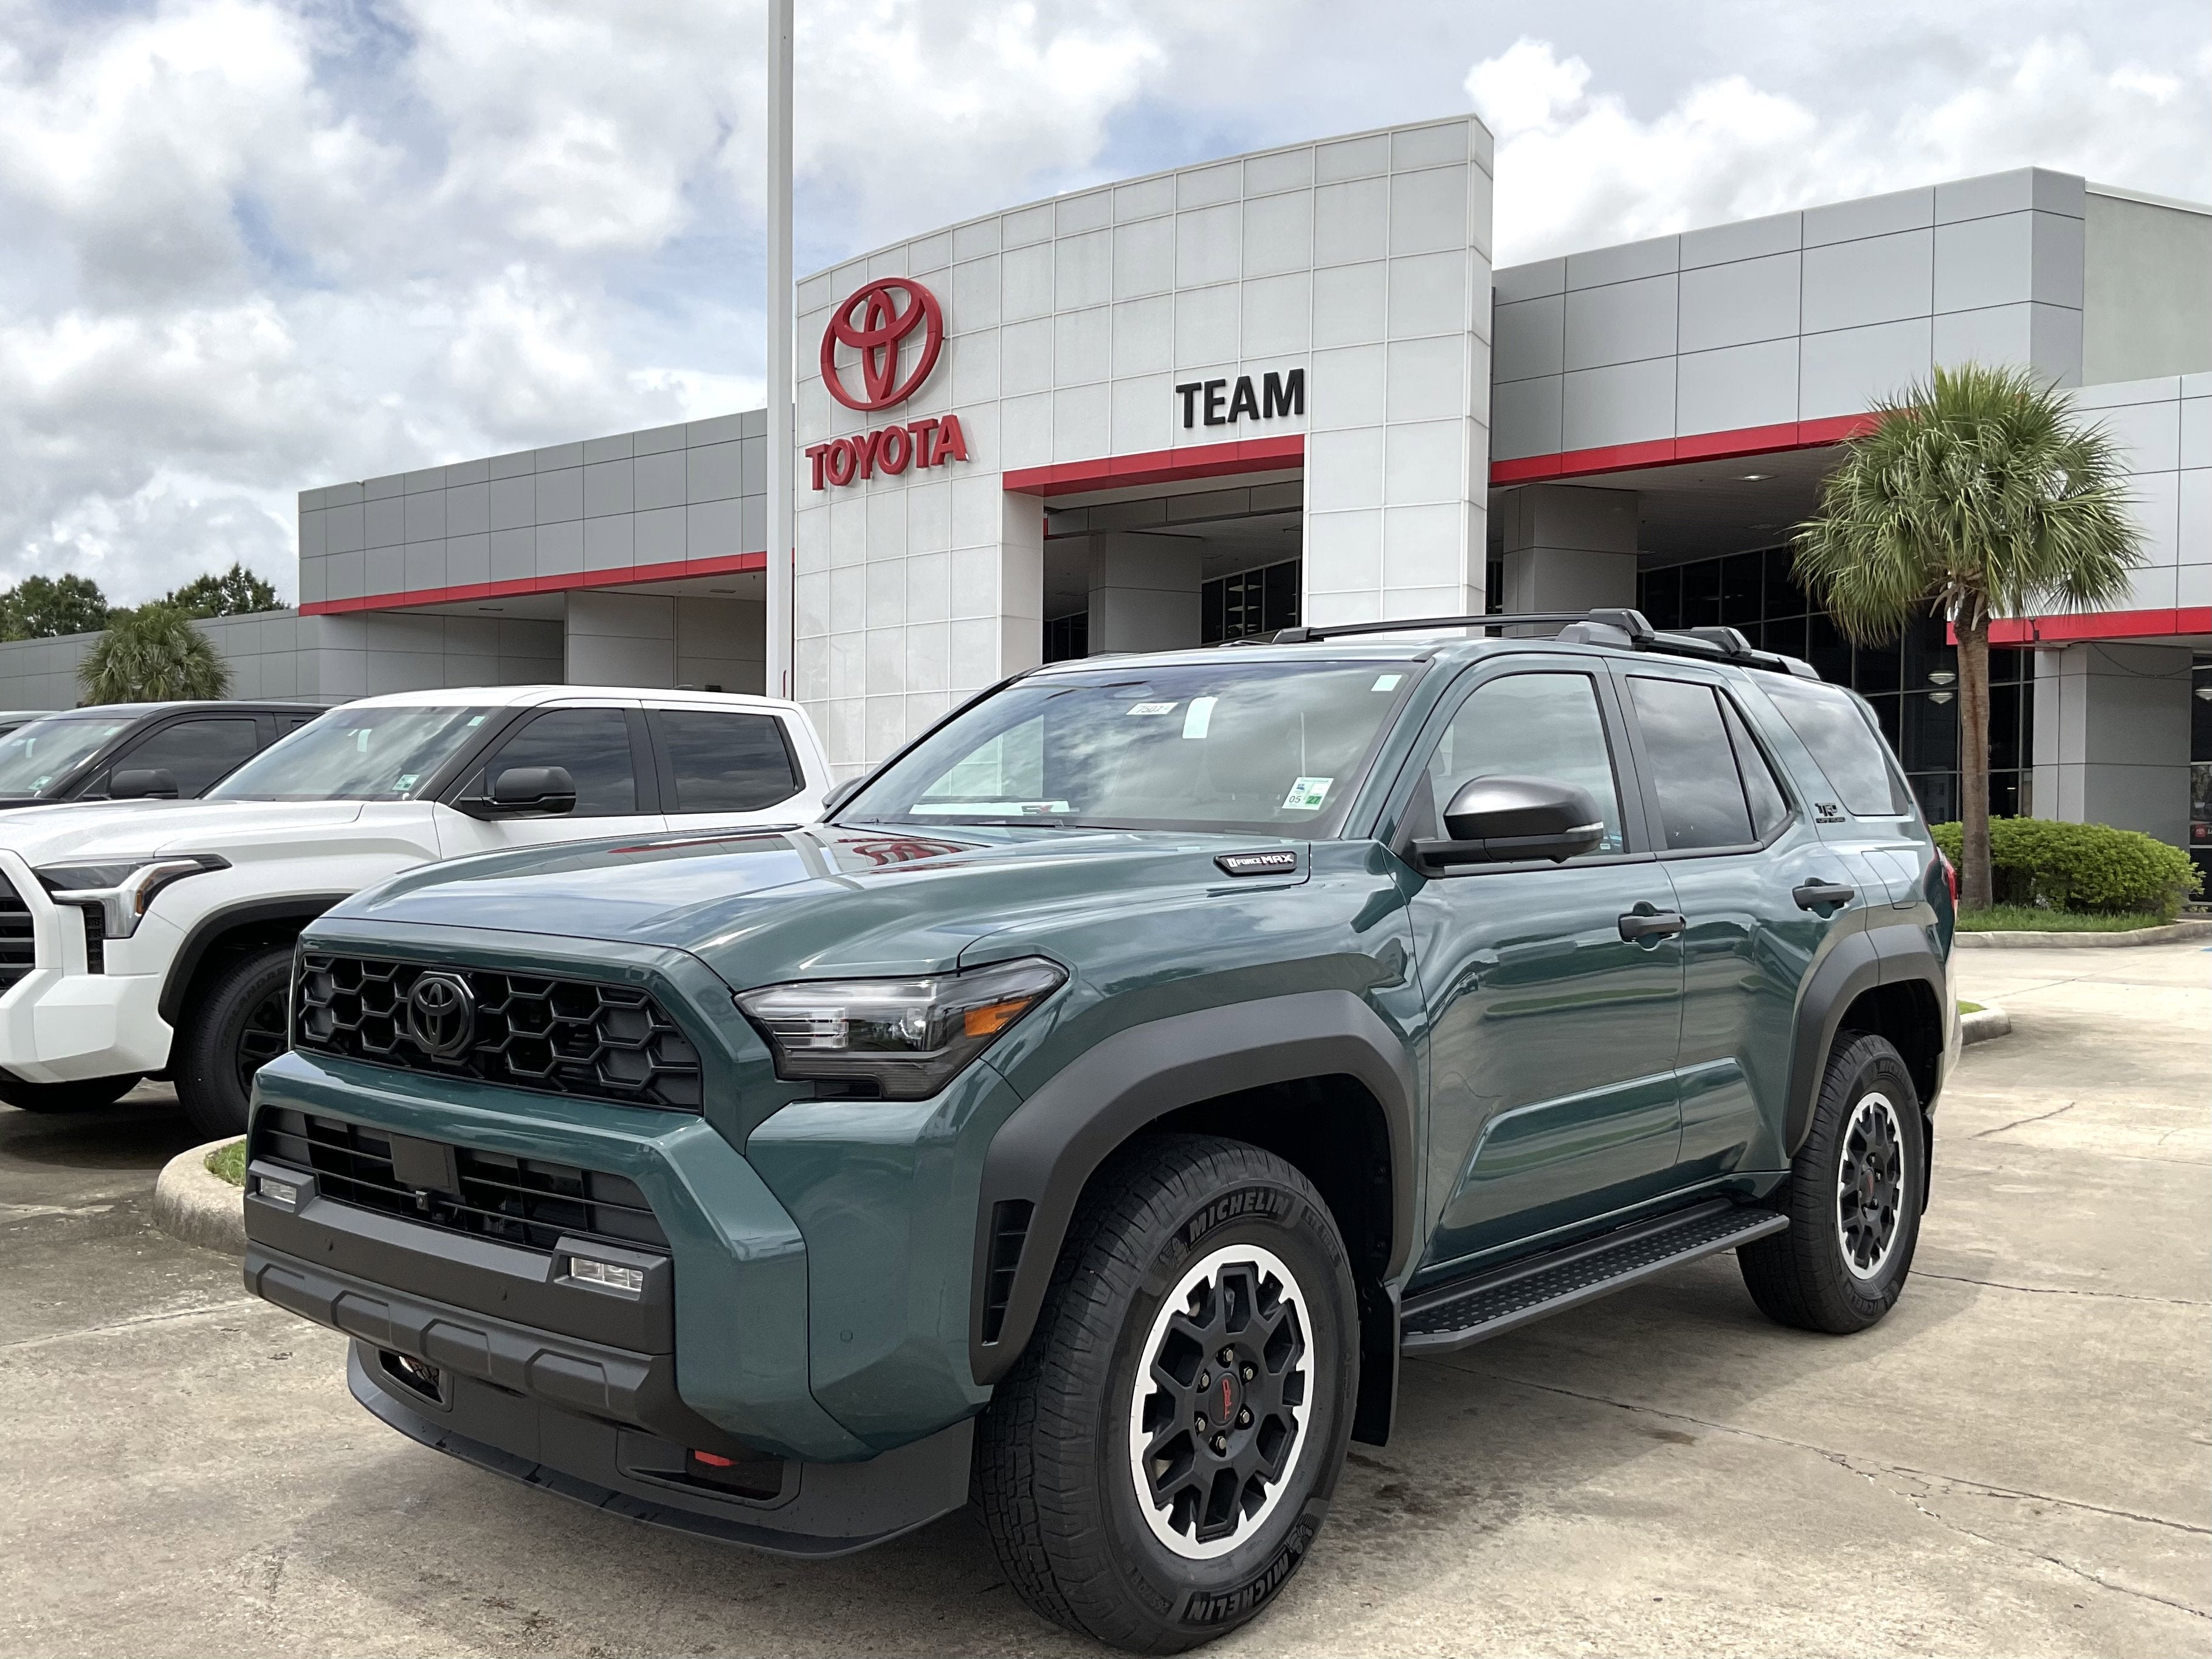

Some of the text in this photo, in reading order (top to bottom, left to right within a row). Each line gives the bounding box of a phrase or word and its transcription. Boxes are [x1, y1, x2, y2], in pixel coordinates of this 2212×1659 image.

[1176, 368, 1304, 428] TEAM
[805, 414, 969, 491] TOYOTA
[1260, 854, 1294, 864] MAX
[1189, 1192, 1289, 1243] MICHELIN
[1187, 1553, 1289, 1620] MICHELIN
